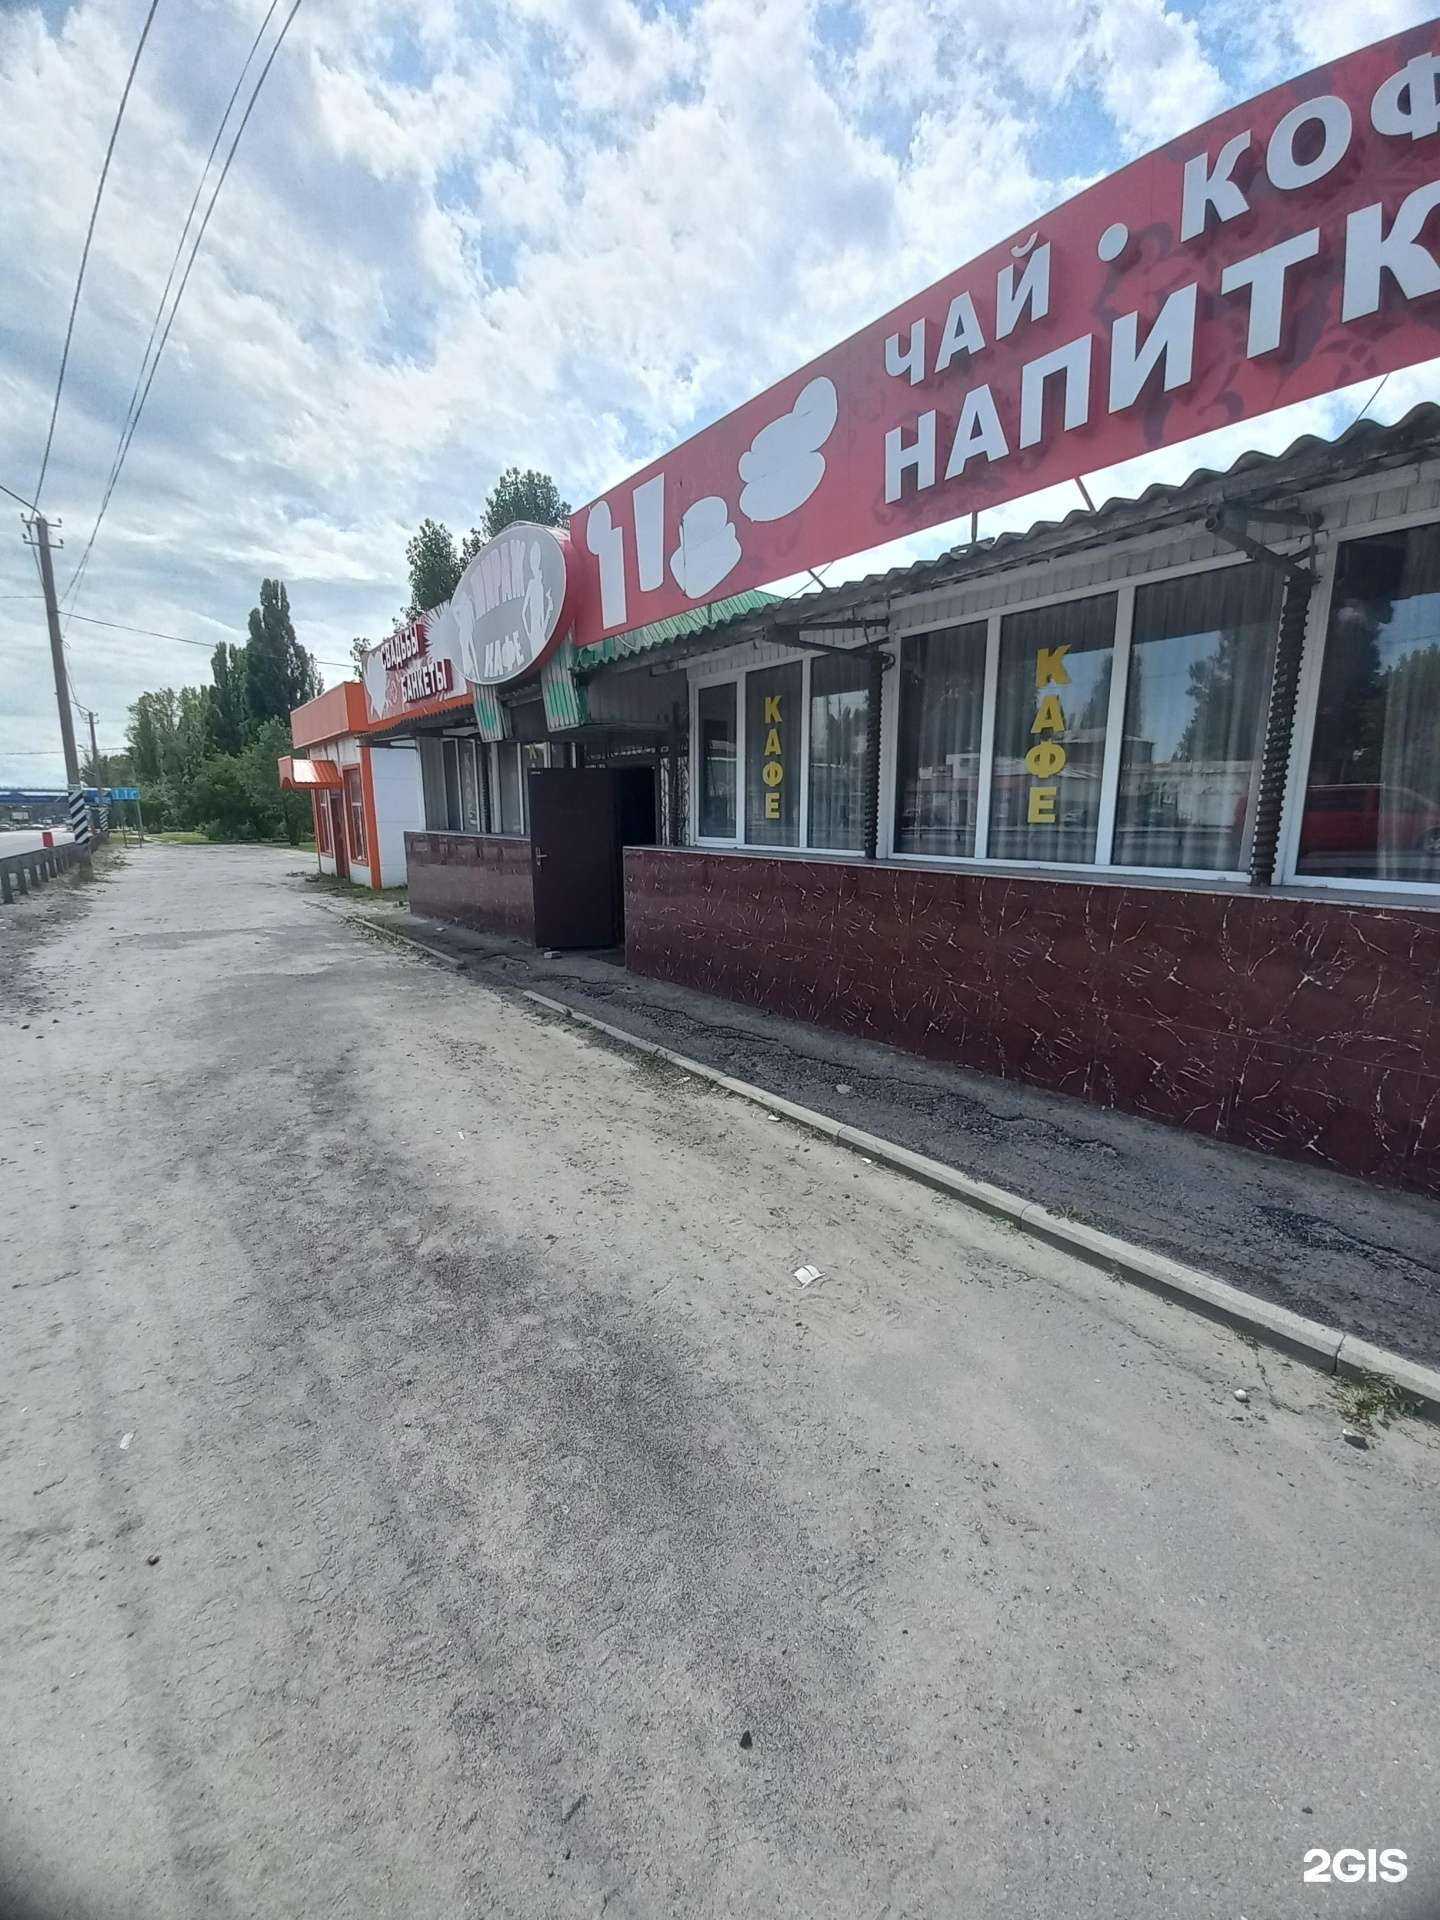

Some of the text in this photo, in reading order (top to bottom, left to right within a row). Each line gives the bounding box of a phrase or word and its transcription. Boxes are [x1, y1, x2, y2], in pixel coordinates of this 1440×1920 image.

[885, 232, 1051, 386] ЧАЙ
[885, 180, 1440, 505] НАПИТК
[380, 624, 419, 670] СВАДЬБЫ
[401, 659, 448, 702] БАНКЕТЫ
[763, 695, 784, 820] КАФЕ
[1024, 644, 1073, 824] КАФЕ
